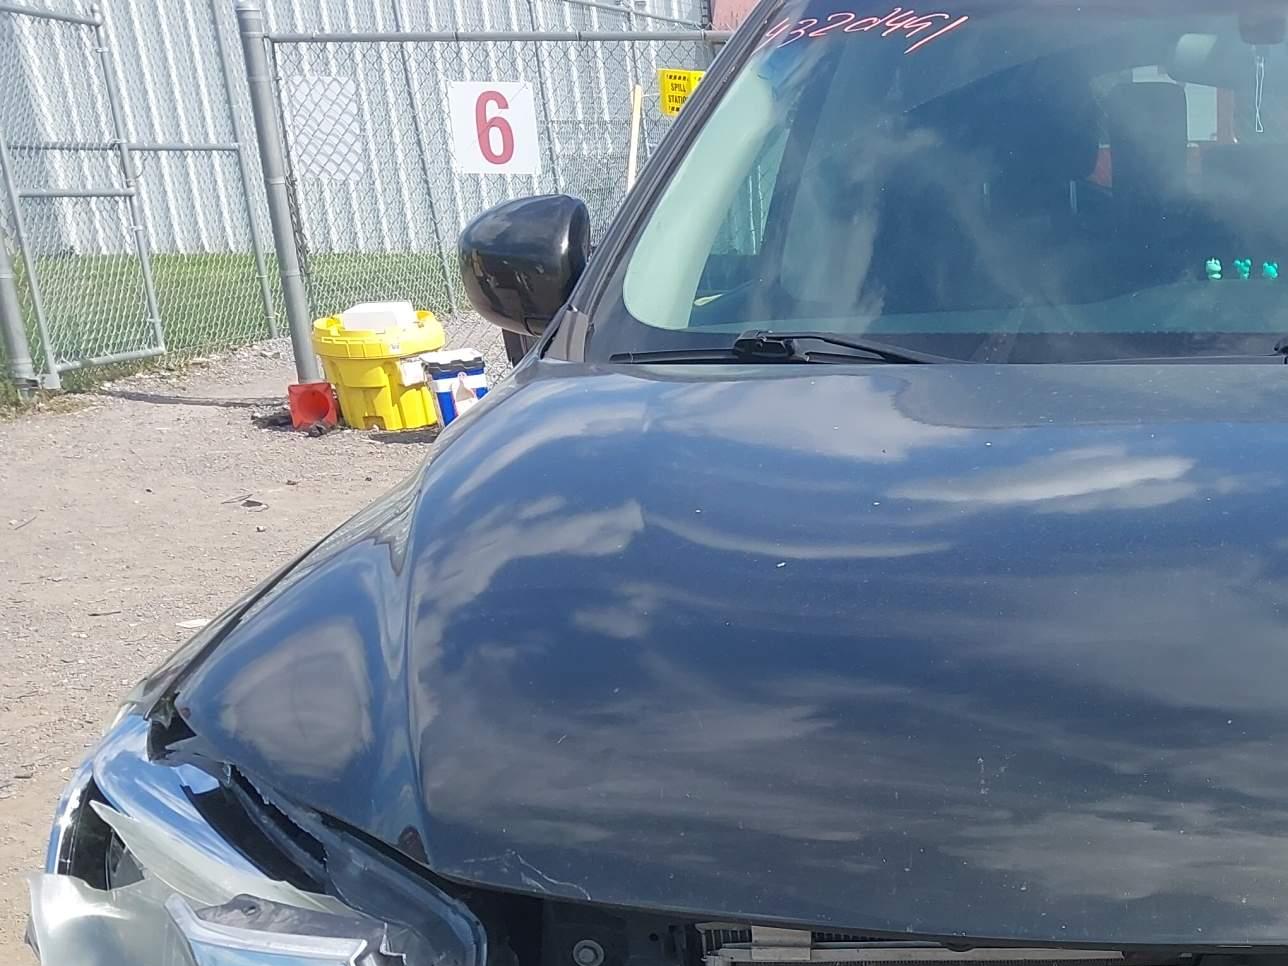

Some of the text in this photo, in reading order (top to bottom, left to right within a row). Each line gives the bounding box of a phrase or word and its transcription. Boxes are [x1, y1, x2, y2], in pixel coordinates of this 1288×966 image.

[671, 83, 686, 92] SPILL
[668, 95, 688, 104] STATIO
[475, 90, 515, 165] 6
